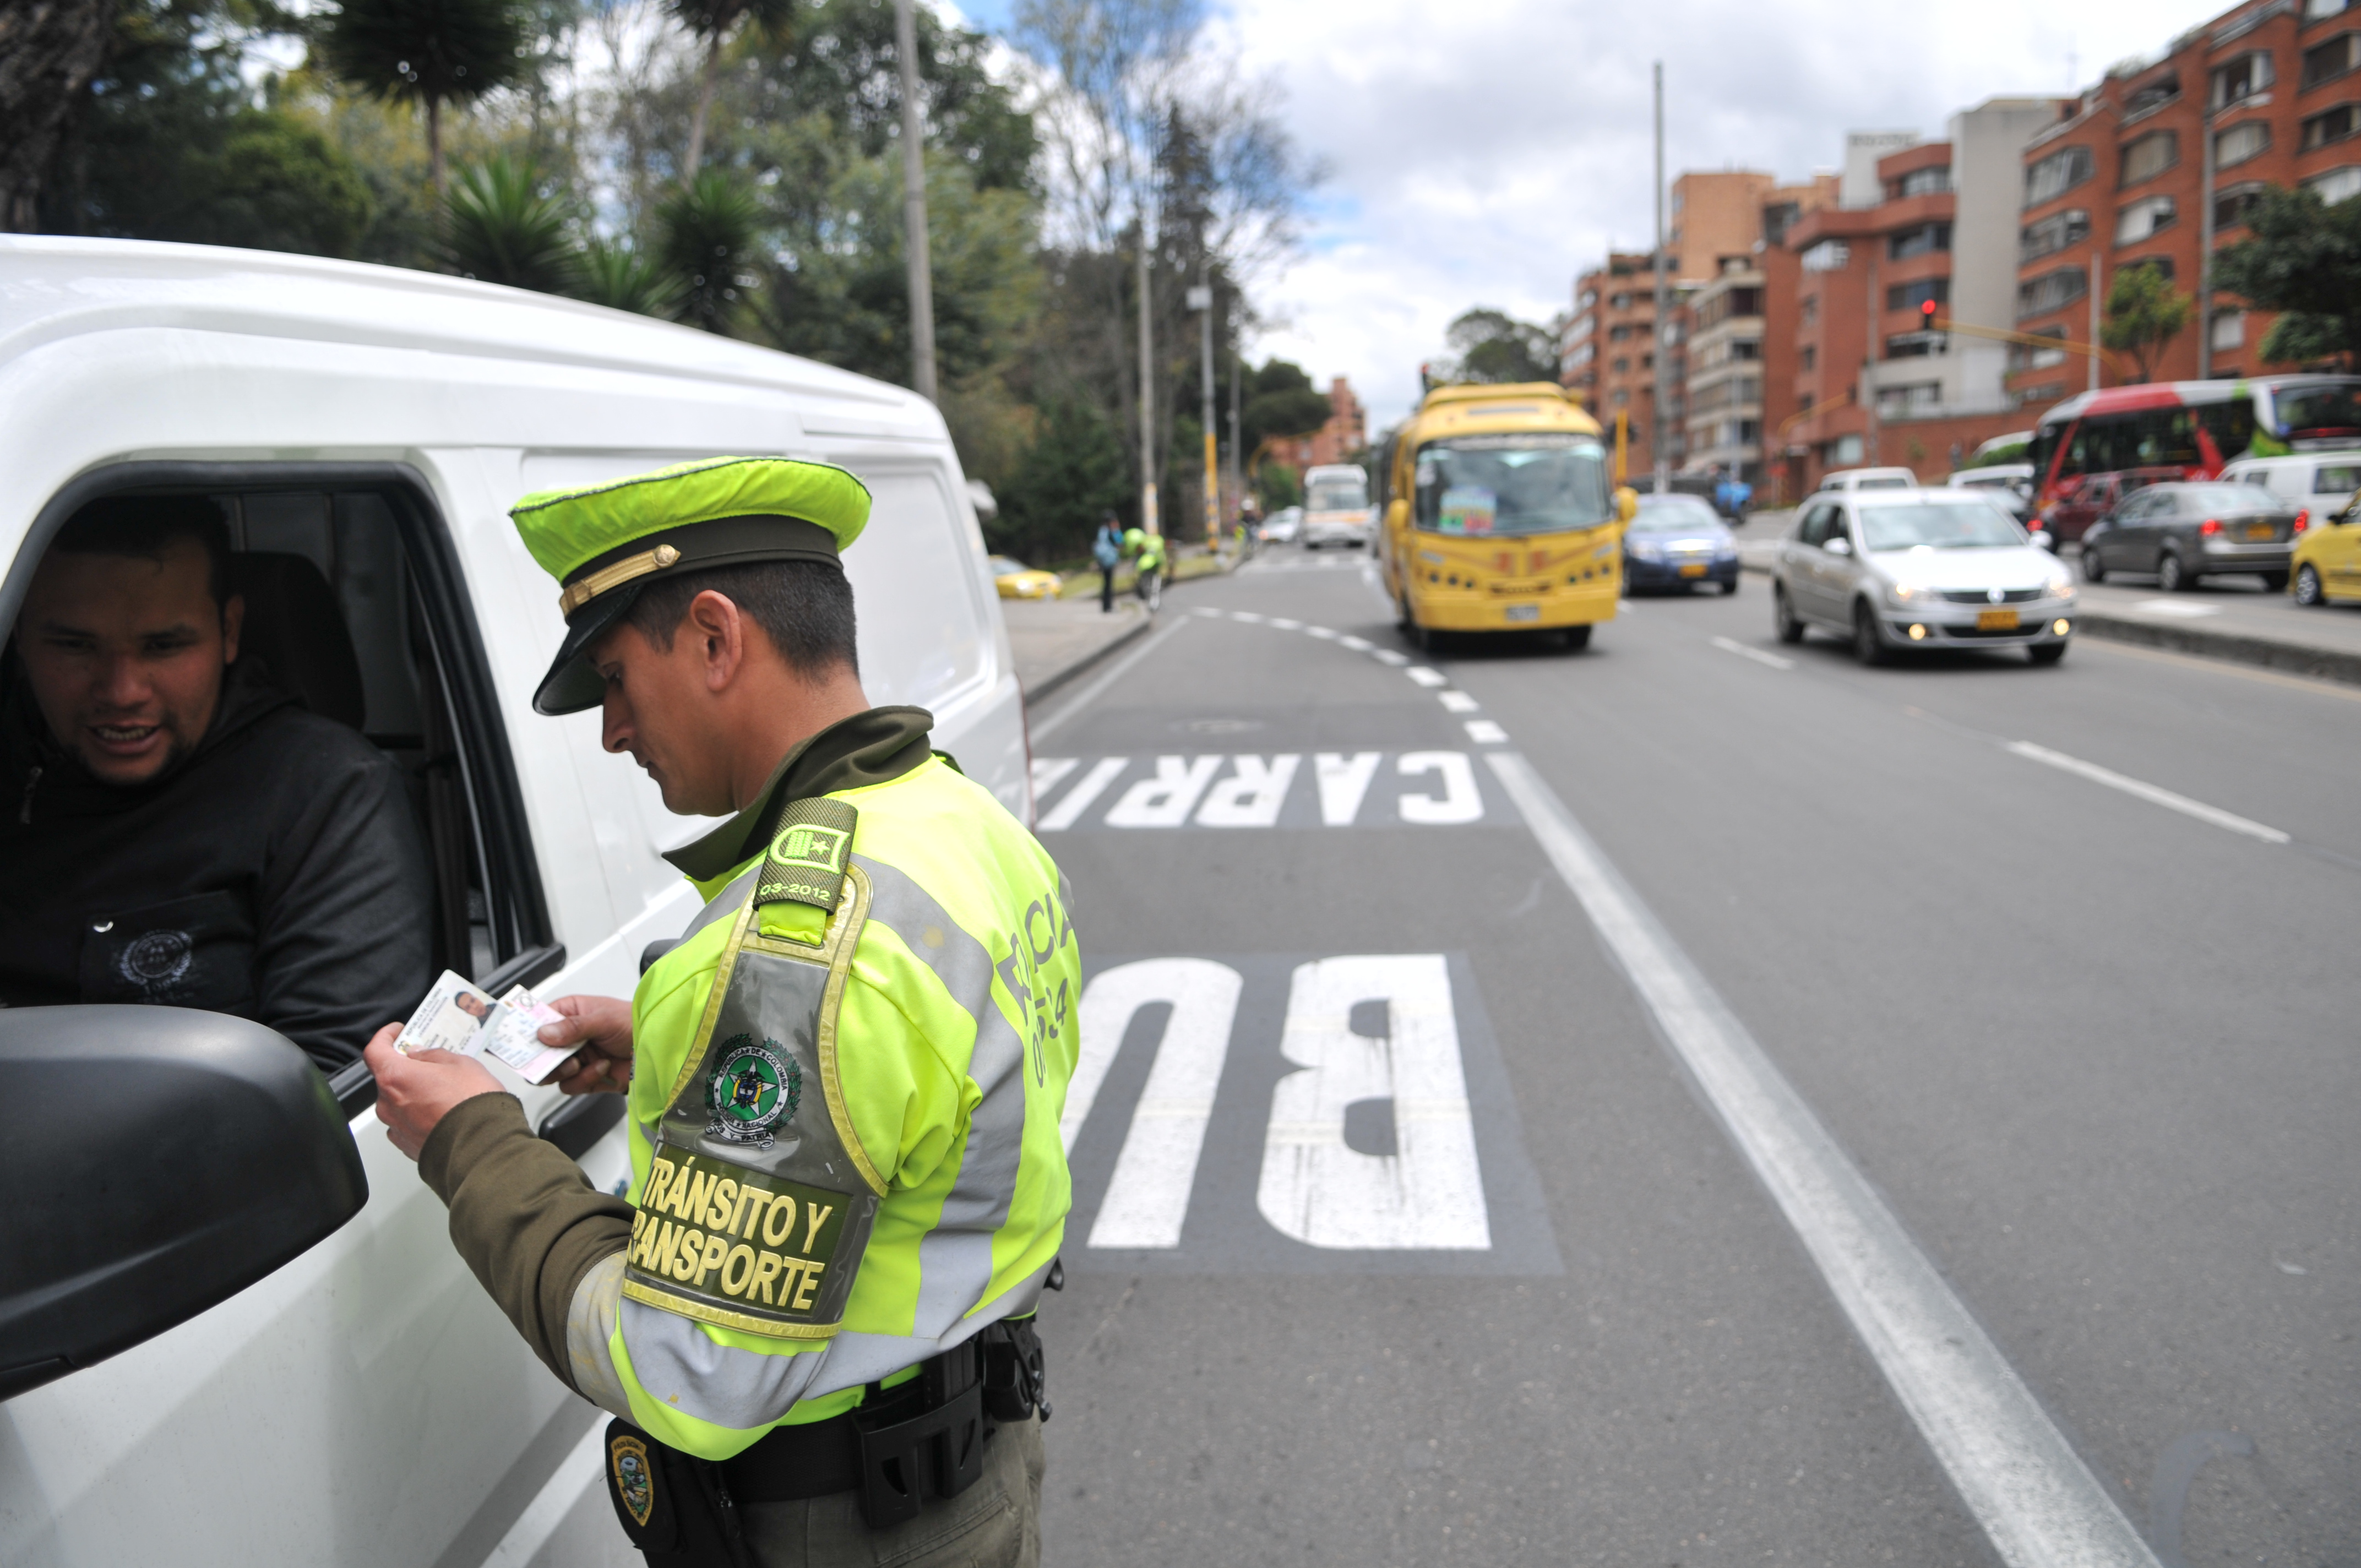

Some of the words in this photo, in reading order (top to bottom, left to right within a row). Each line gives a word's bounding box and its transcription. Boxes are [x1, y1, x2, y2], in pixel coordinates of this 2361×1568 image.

[760, 883, 831, 901] 03-2012
[719, 1049, 746, 1078] REPUBLICA
[766, 1054, 787, 1091] COLOMBIA
[742, 1112, 777, 1129] NACIONAL
[1059, 954, 1492, 1250] BU
[741, 1131, 771, 1140] PATRIA
[642, 1156, 796, 1247] TRÁNSITO
[802, 1202, 833, 1254] Y
[627, 1210, 825, 1310] RANSPORTE
